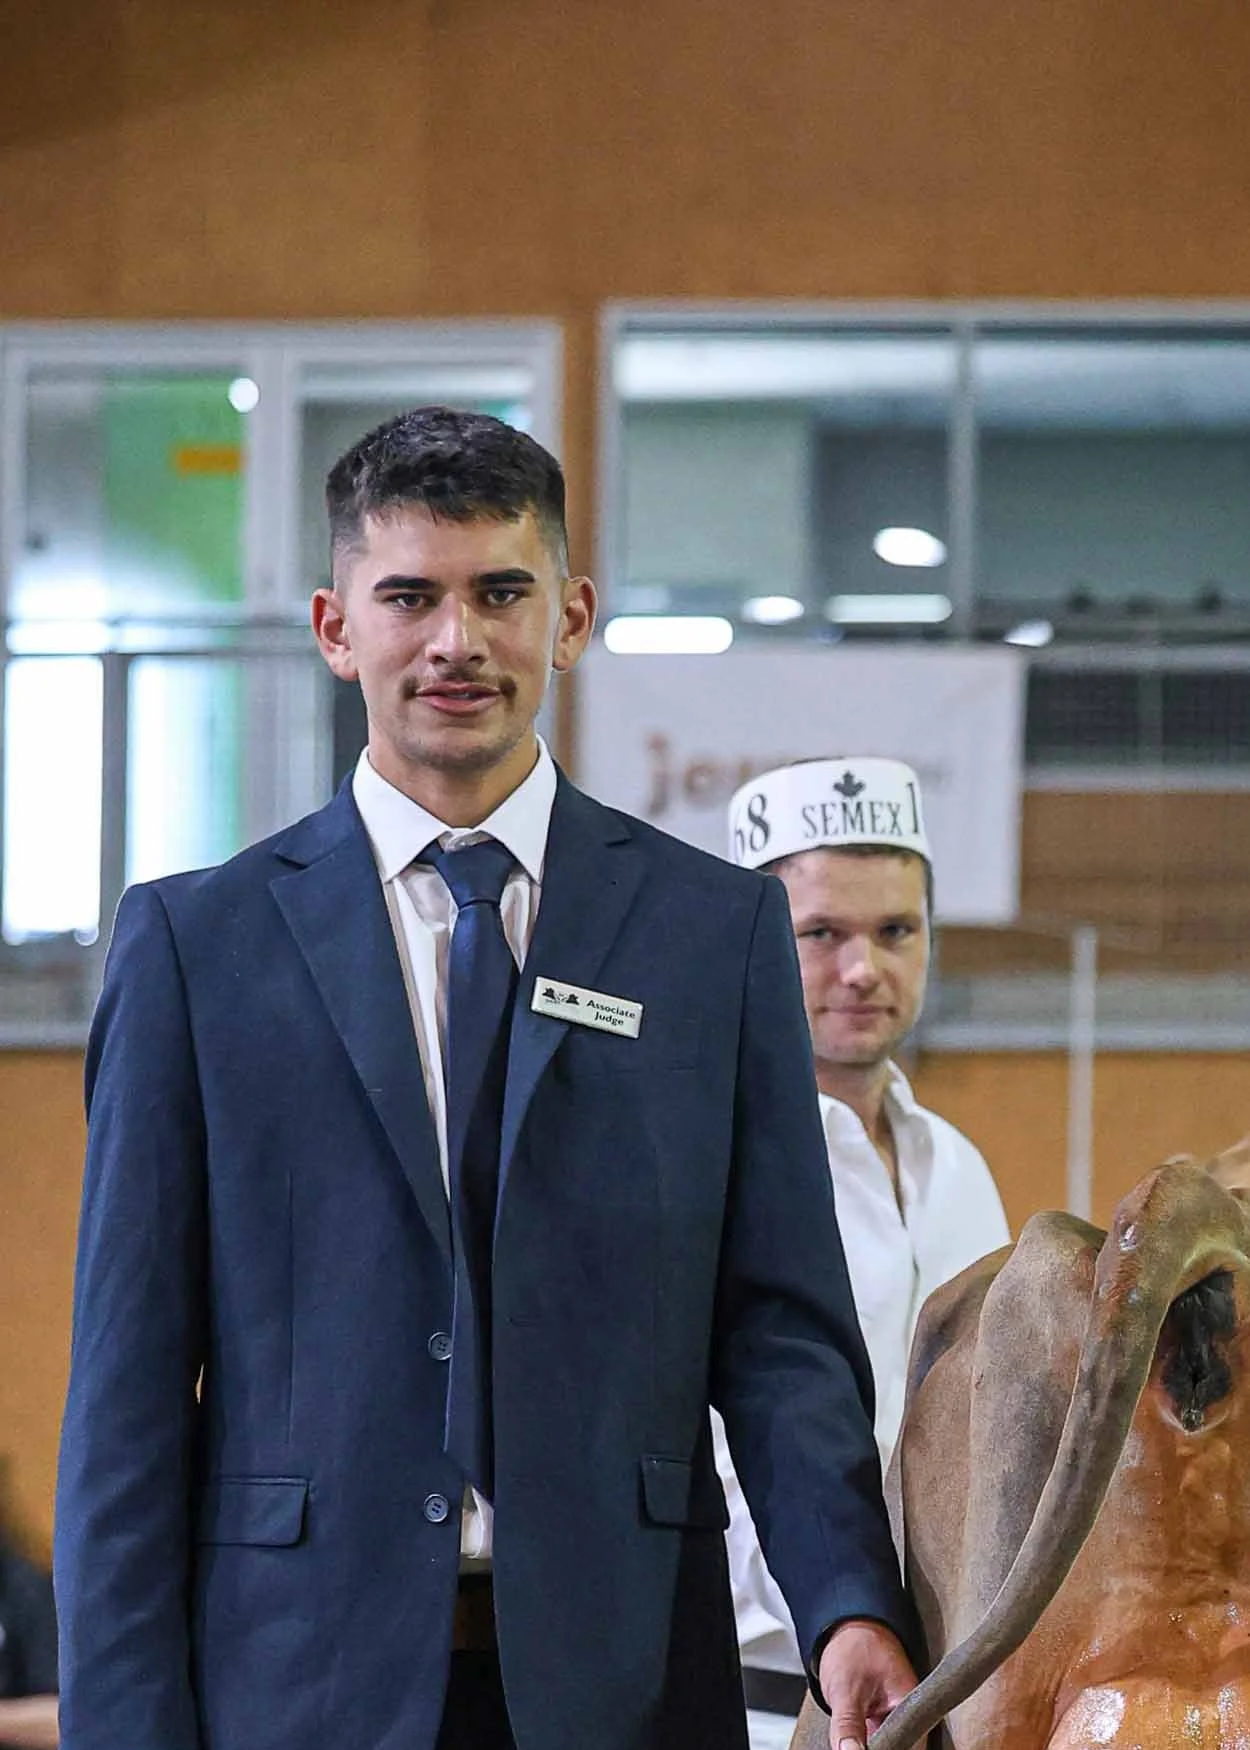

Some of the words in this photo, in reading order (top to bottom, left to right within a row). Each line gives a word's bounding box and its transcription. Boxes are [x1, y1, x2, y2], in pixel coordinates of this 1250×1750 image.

[801, 800, 904, 839] SEMEX
[587, 1000, 636, 1019] Associate
[595, 1012, 624, 1026] Judge
